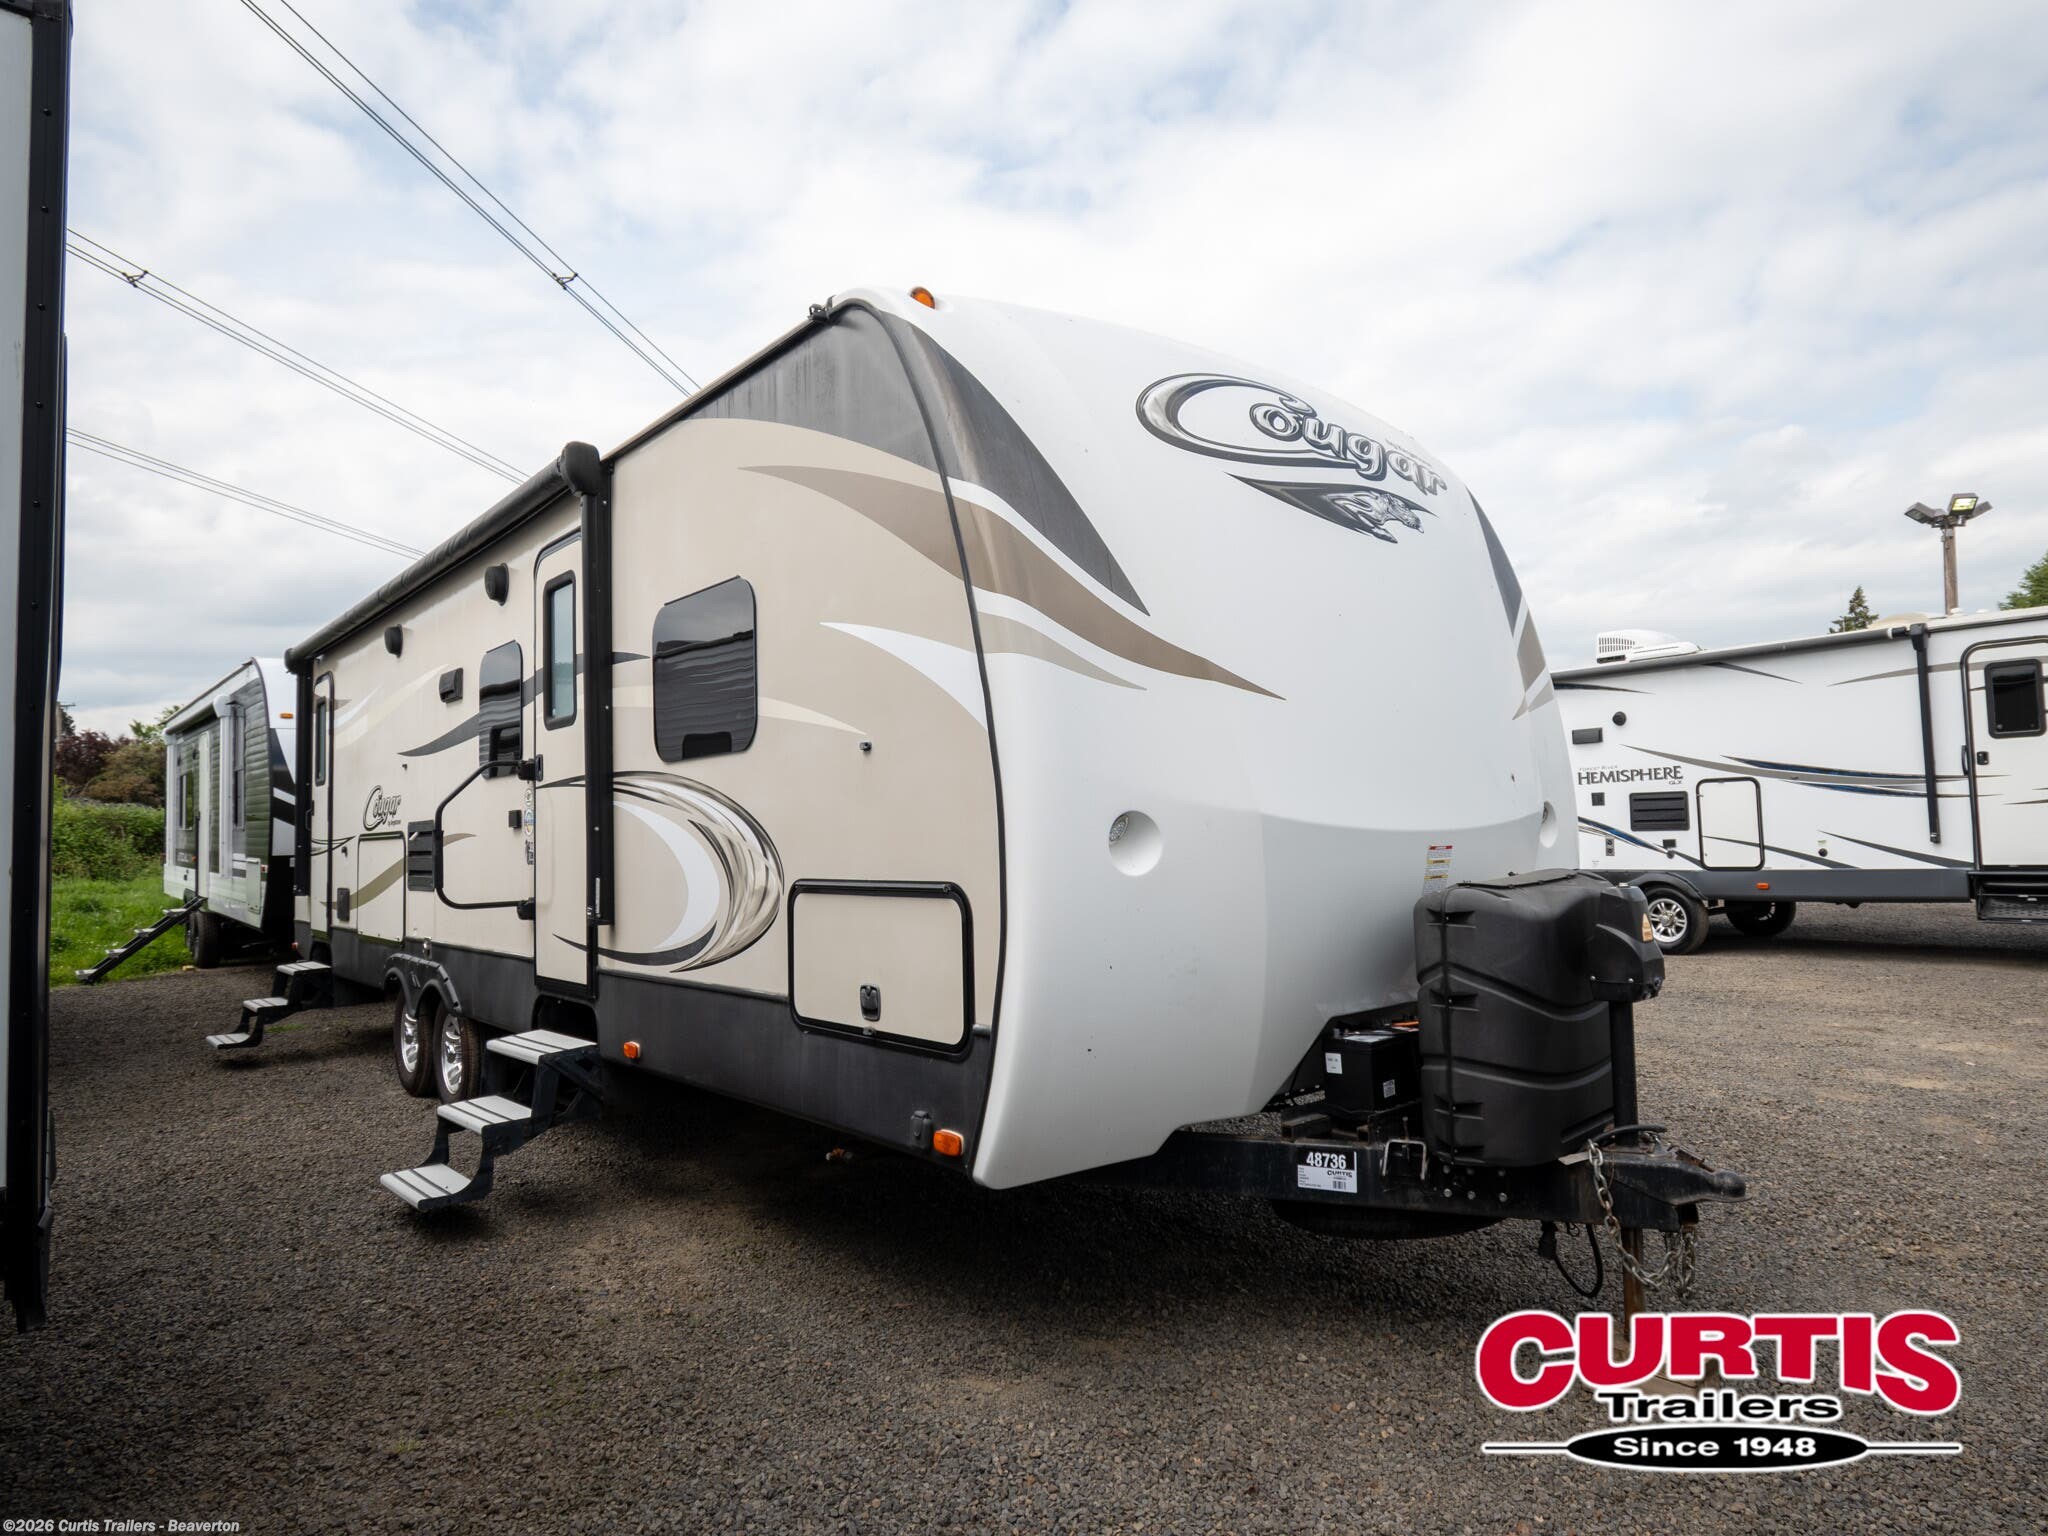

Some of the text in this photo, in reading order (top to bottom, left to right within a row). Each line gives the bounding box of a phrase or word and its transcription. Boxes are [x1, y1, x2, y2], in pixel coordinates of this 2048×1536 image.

[1135, 372, 1447, 496] Cougar
[1577, 765, 1684, 786] HEMISPHERE
[1306, 1151, 1347, 1170] 48736
